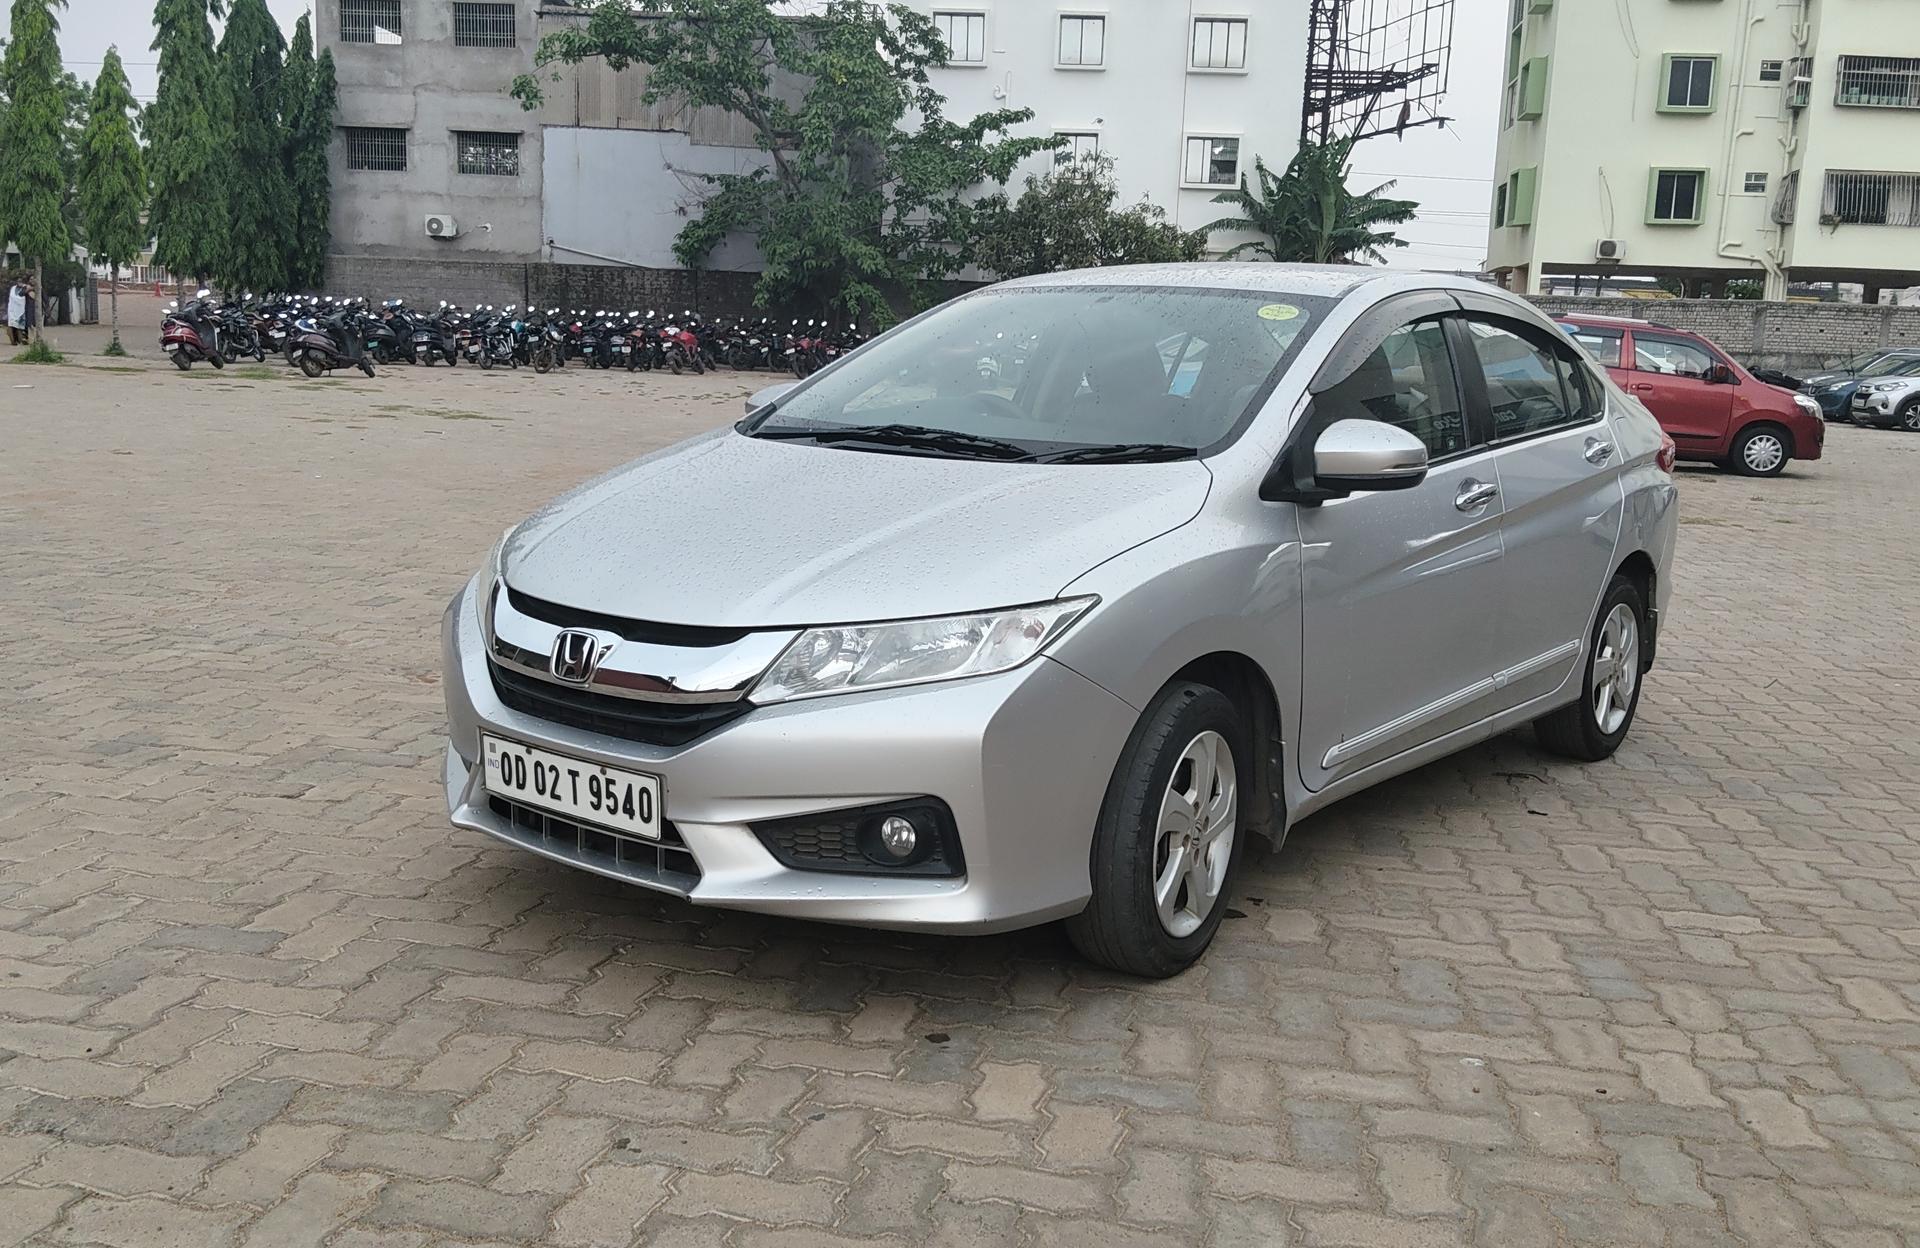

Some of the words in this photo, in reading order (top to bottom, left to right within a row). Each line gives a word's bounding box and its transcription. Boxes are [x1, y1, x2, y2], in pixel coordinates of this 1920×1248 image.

[487, 757, 500, 769] IND
[501, 751, 527, 790] OD
[533, 761, 561, 801] 02
[567, 768, 580, 806] T
[588, 774, 653, 824] 9540
